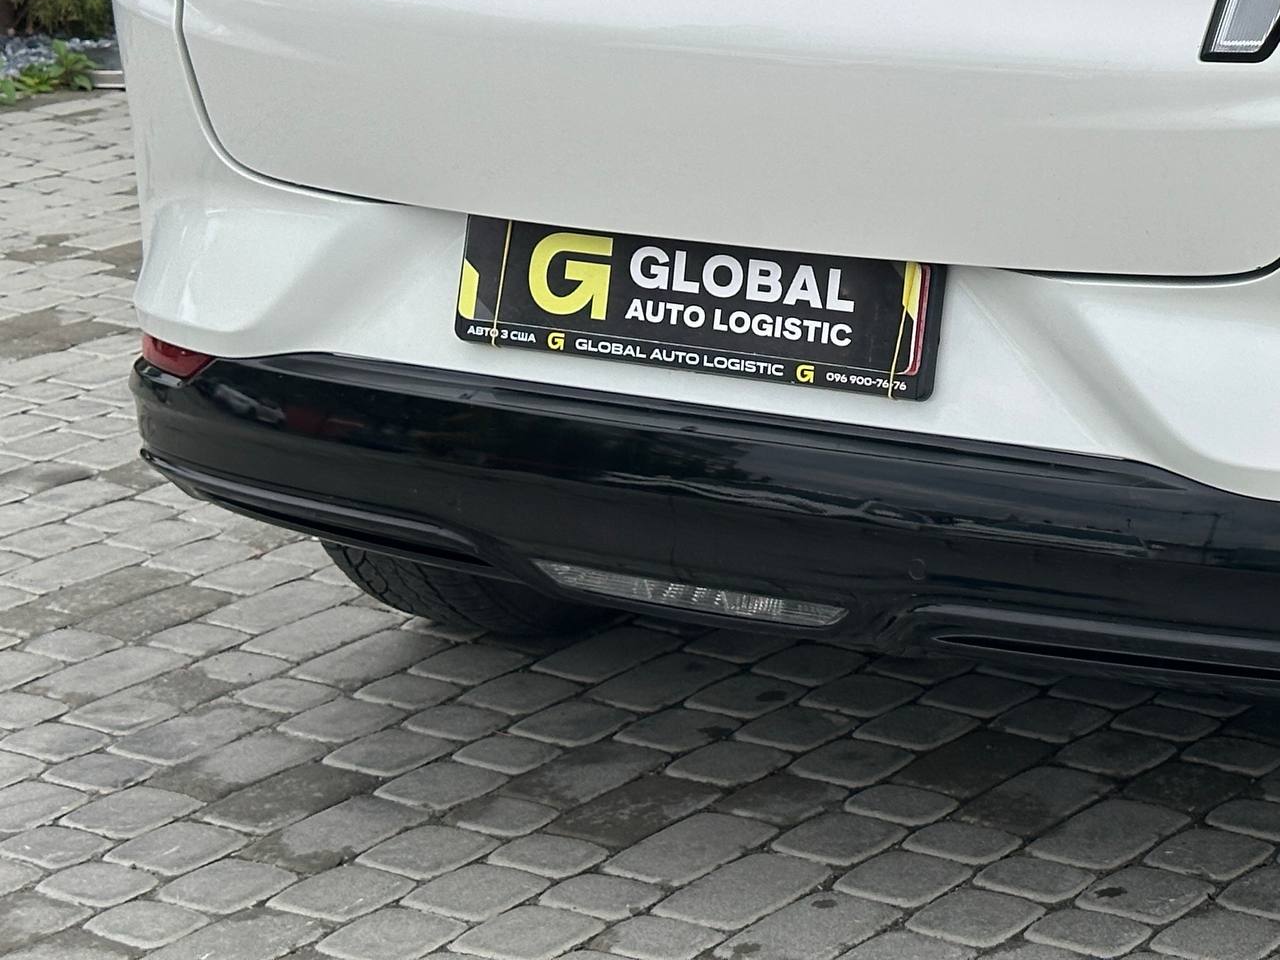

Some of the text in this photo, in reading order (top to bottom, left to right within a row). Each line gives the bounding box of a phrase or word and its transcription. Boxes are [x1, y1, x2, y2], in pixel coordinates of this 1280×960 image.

[629, 246, 855, 313] GLOBAL
[466, 325, 499, 338] АВТО
[510, 330, 537, 343] США
[625, 298, 853, 347] AUTO LOGISTIC
[575, 338, 785, 376] GLOBAL AUTO LOGISTIC
[825, 372, 848, 383] 096
